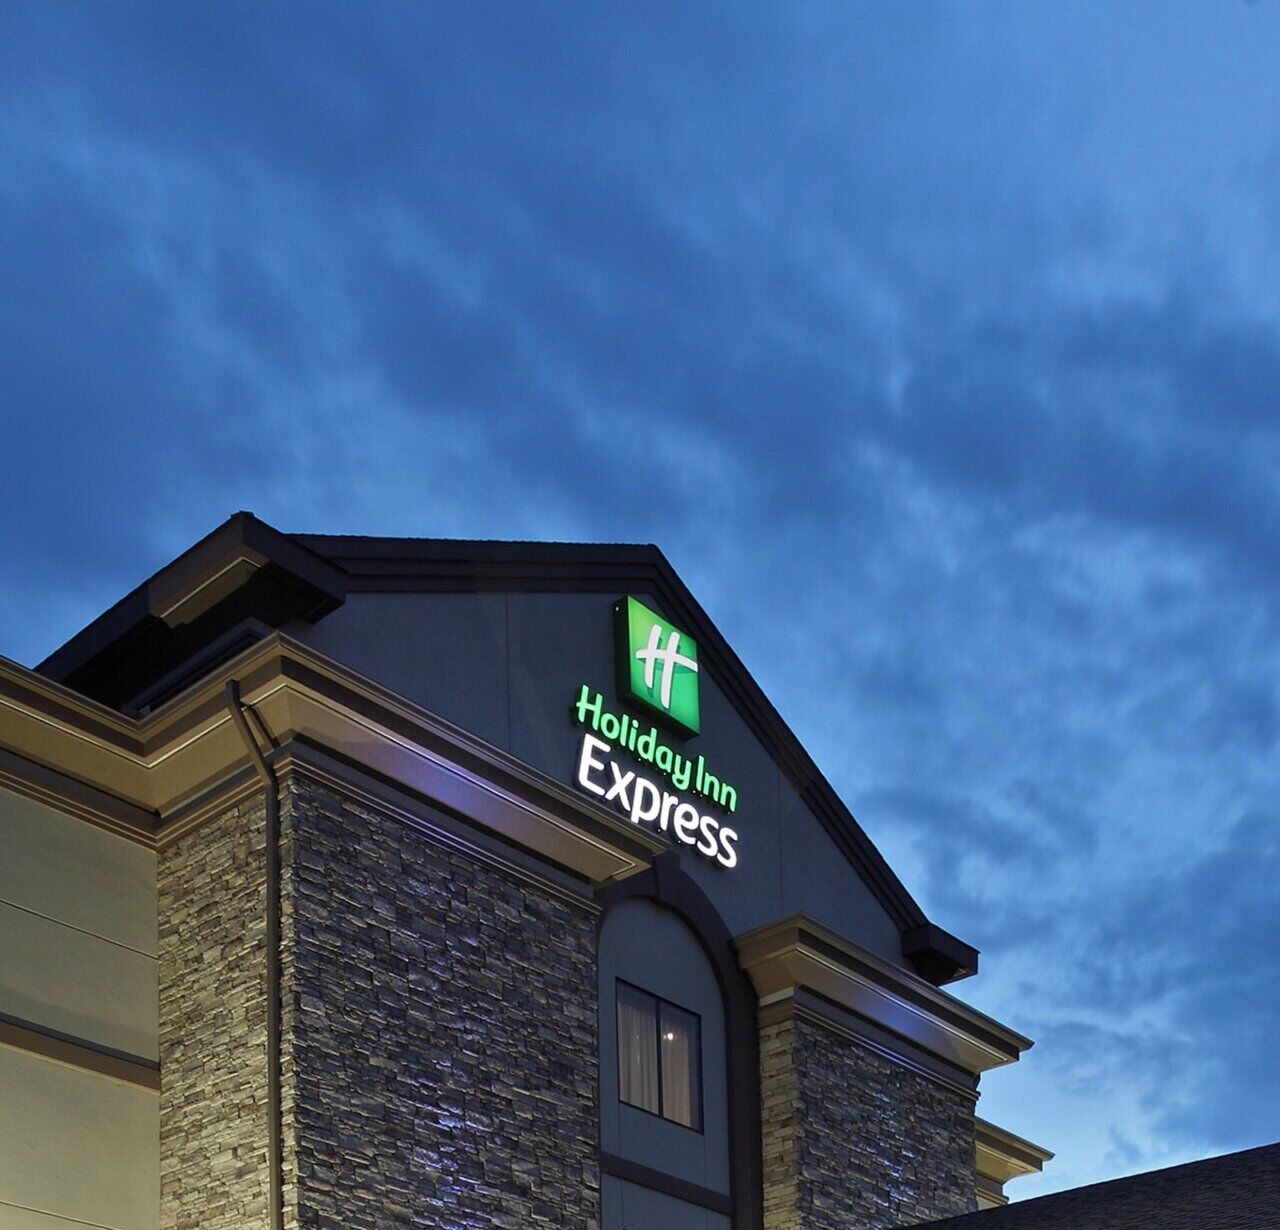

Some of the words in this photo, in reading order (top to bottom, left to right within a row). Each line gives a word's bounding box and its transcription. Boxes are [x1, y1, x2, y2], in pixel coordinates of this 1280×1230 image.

[576, 684, 692, 791] Holiday
[696, 755, 738, 812] Inn
[578, 733, 738, 868] Express
